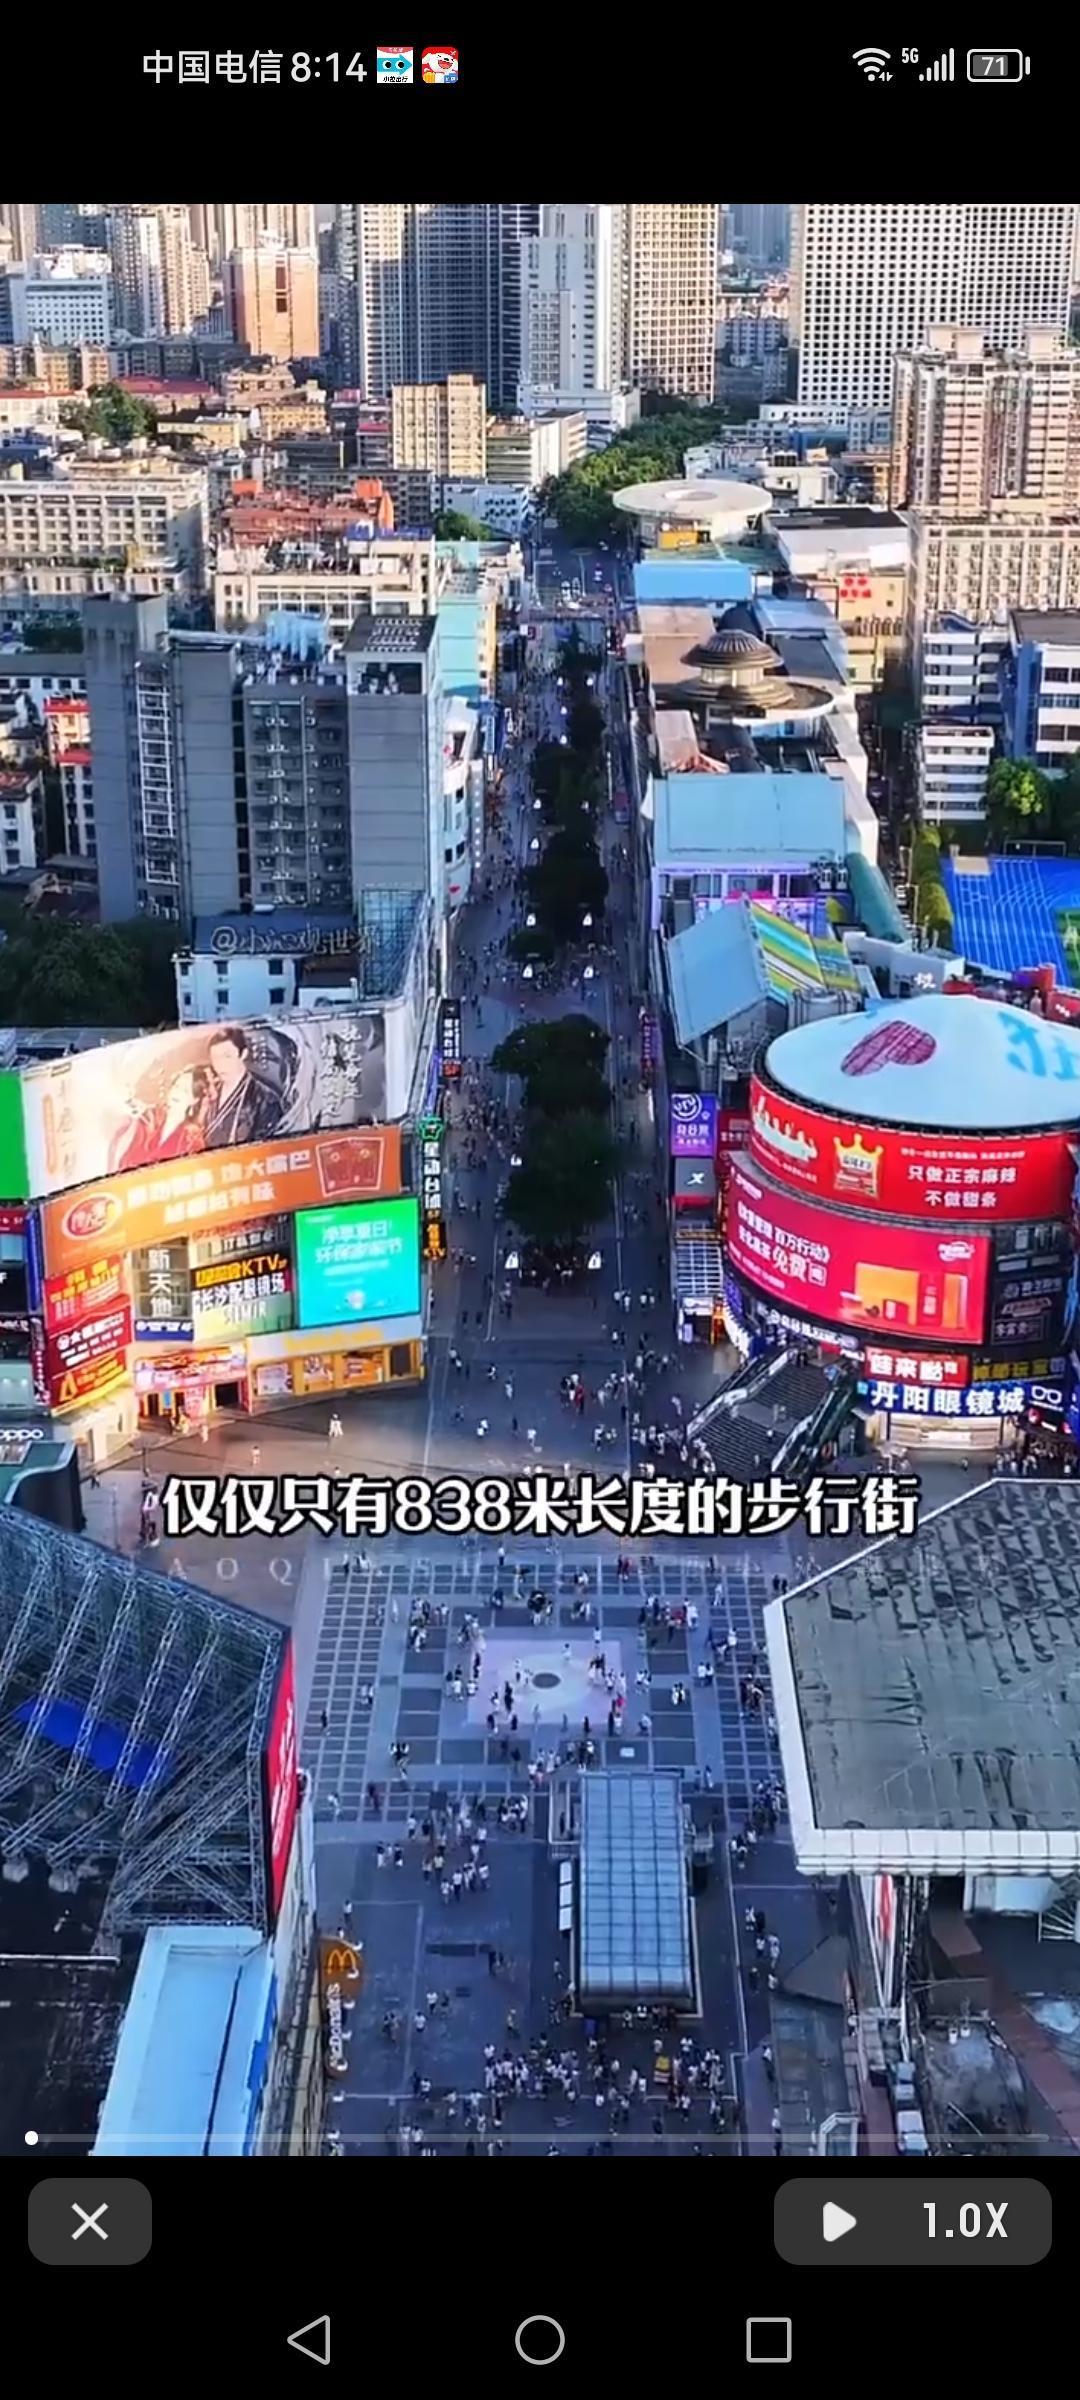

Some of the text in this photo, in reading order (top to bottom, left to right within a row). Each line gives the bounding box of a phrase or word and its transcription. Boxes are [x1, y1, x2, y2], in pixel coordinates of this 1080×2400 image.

[143, 49, 284, 84] 中国电信
[290, 52, 368, 82] 8:14
[901, 47, 919, 64] 5G
[981, 56, 1006, 76] 71
[907, 1164, 1018, 1184] 只做正宗麻辣
[870, 1380, 1026, 1416] 丹阳眼镜城
[923, 2202, 1009, 2238] 1.0X
